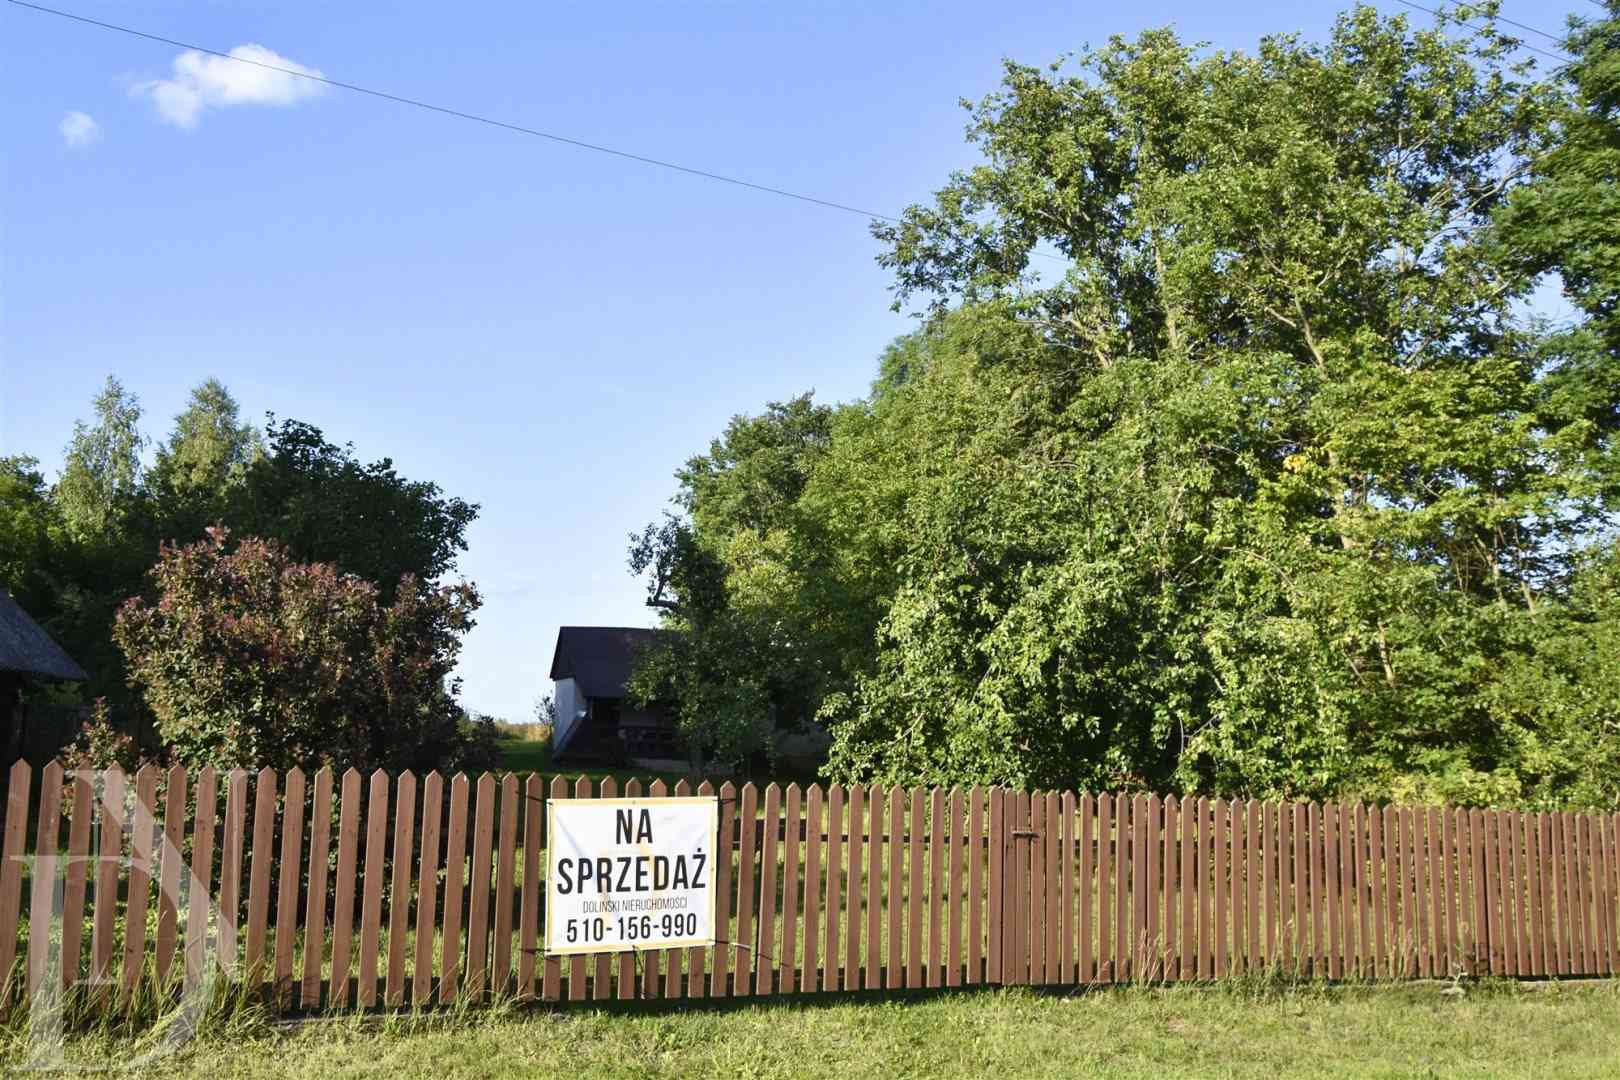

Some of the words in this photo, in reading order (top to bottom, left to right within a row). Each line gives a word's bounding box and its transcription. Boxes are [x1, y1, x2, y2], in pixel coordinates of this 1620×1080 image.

[616, 809, 653, 844] NA
[557, 848, 706, 894] SPRZEDAŻ
[567, 913, 697, 942] 510-156-990
